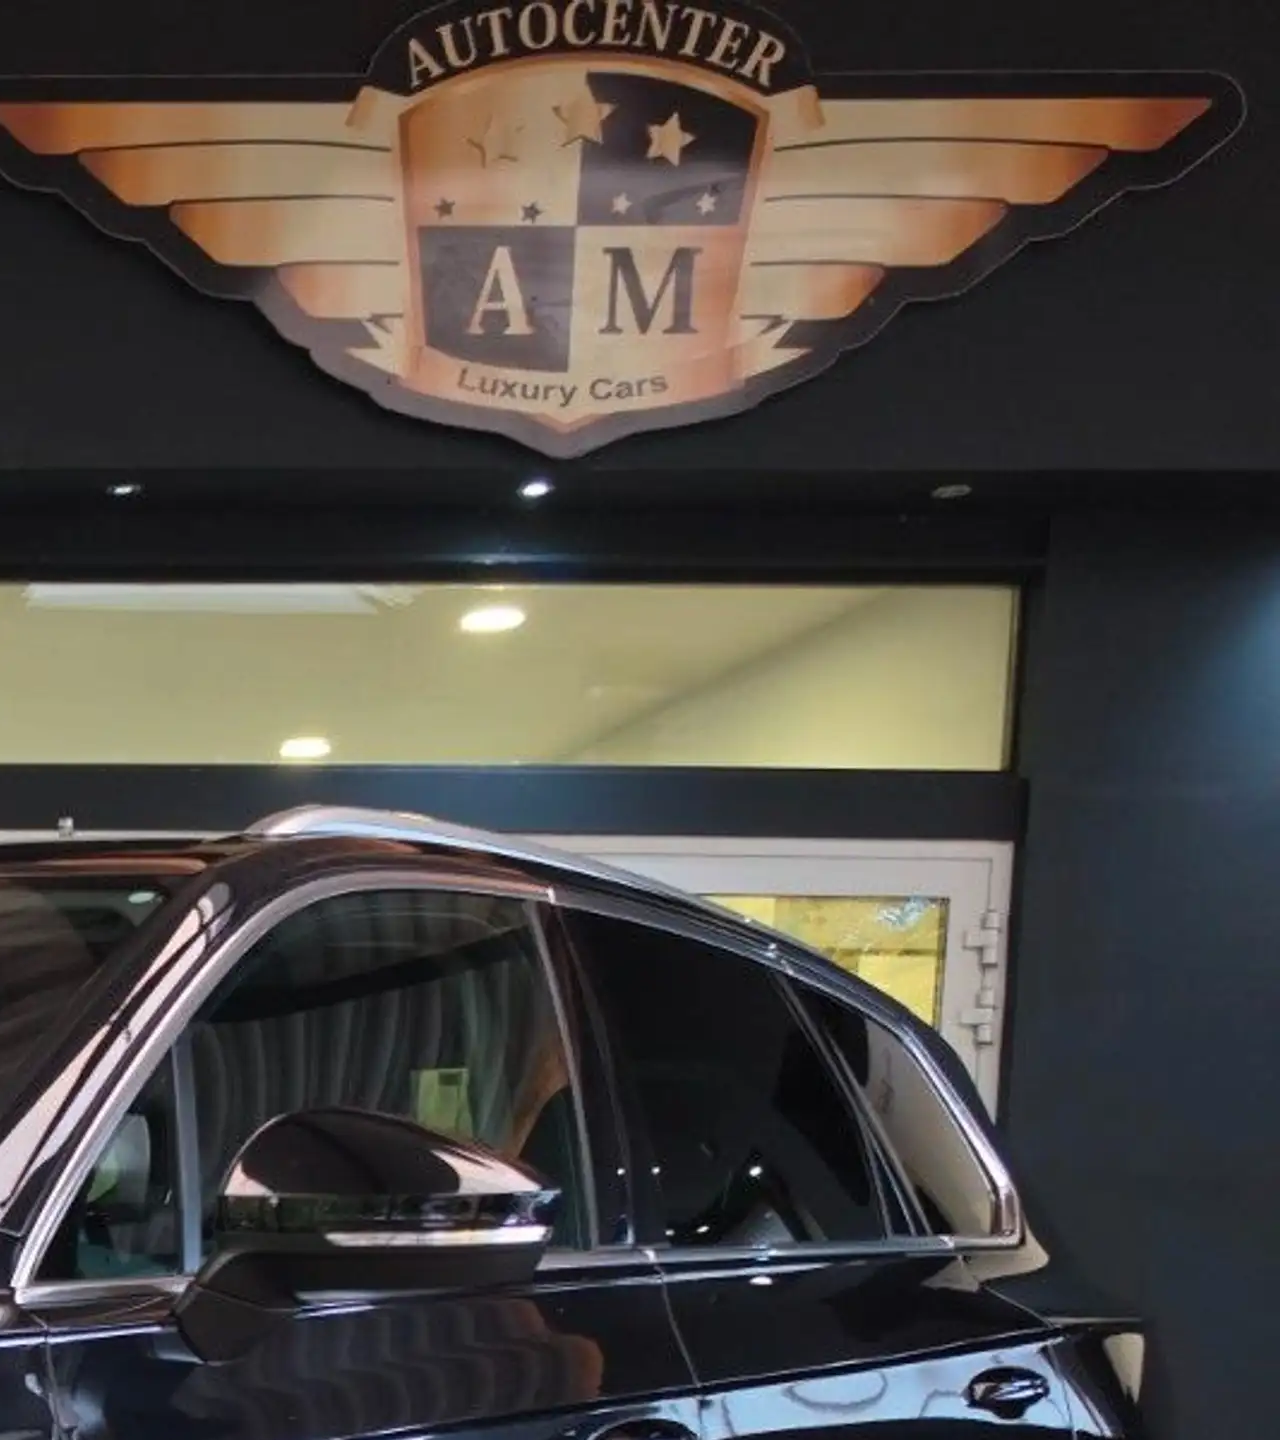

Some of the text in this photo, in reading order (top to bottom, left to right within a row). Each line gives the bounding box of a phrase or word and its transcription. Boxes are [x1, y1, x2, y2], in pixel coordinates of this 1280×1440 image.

[406, 0, 786, 88] AUTOCENTER
[464, 245, 703, 335] A M
[456, 367, 670, 408] Luxury Cars
